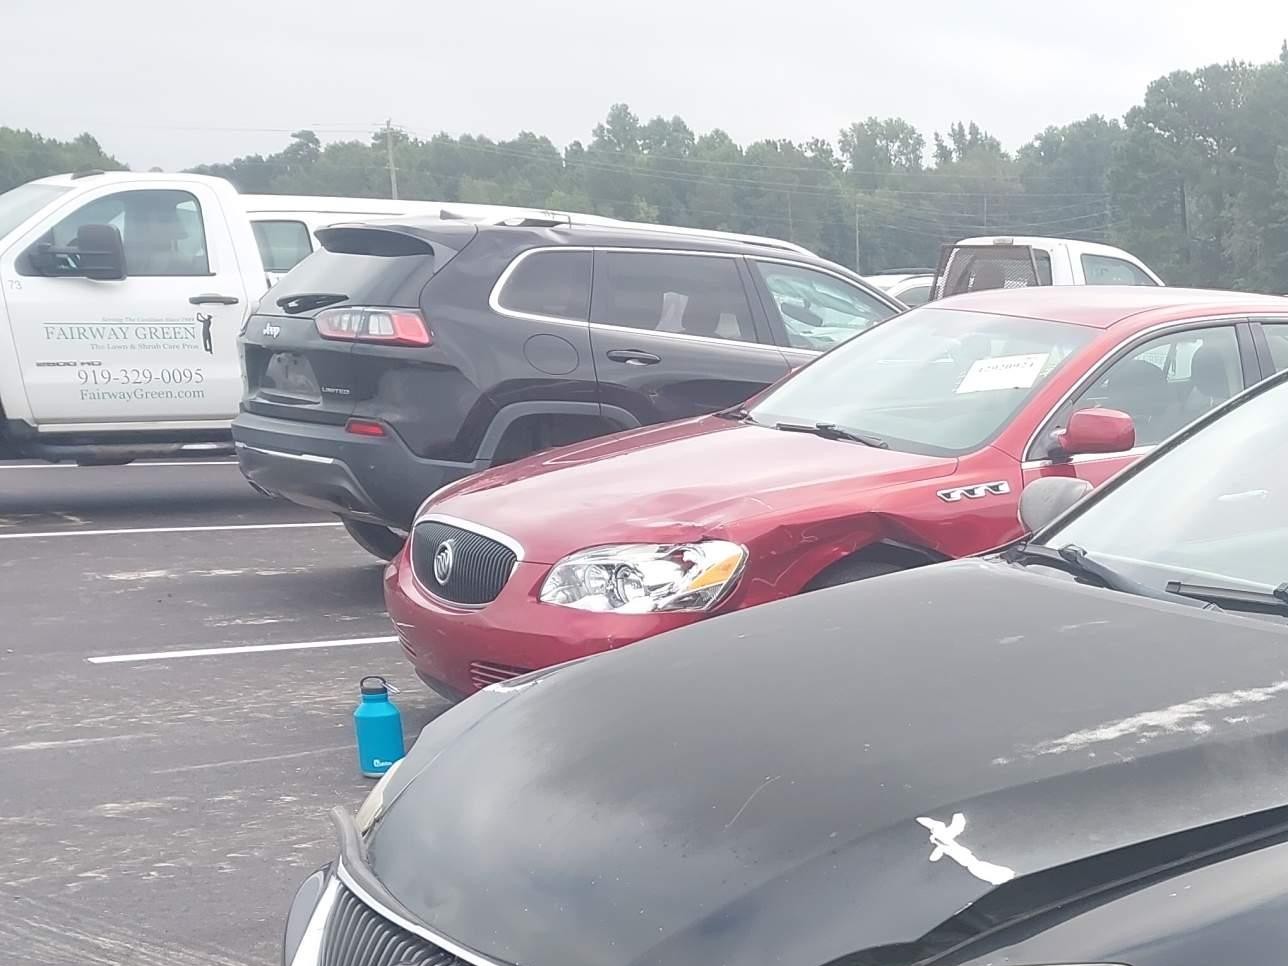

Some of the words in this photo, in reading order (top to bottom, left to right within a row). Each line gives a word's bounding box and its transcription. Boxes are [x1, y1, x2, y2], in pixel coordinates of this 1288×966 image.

[43, 326, 129, 341] FAIRWAY
[134, 326, 196, 341] GREEN
[77, 368, 205, 385] 919-329-0095
[79, 388, 205, 402] FairwayGreen.com
